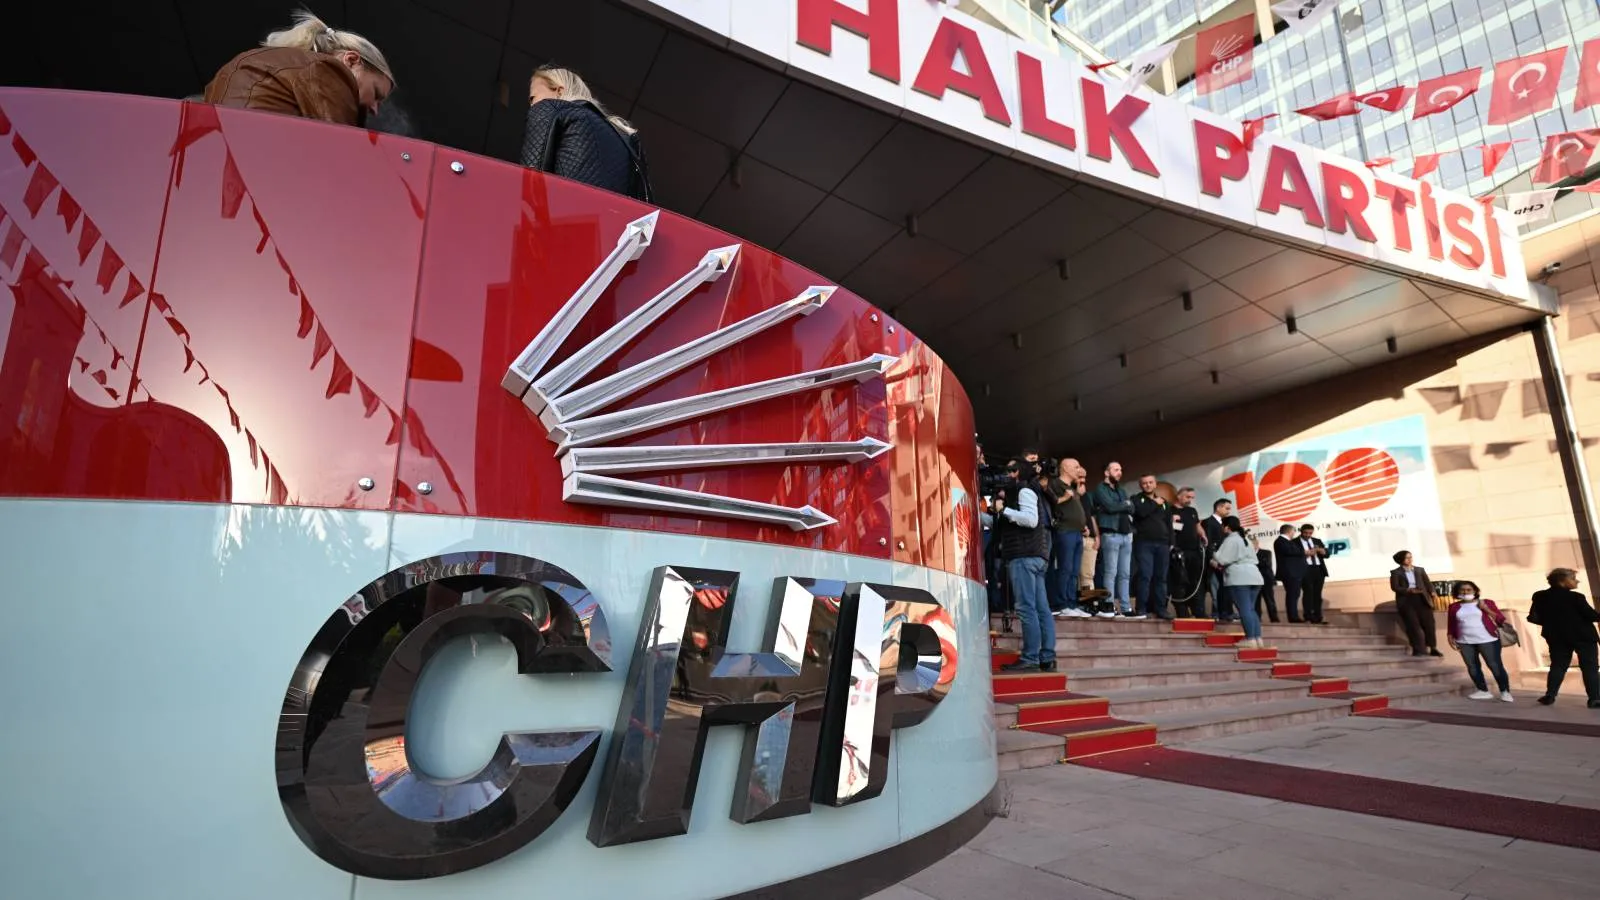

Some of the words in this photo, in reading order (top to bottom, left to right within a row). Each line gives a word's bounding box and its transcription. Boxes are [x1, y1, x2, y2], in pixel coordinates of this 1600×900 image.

[796, 0, 1160, 178] HALK
[1192, 118, 1508, 279] PARTİSİ
[1211, 55, 1245, 74] CHP
[275, 551, 958, 880] CHP
